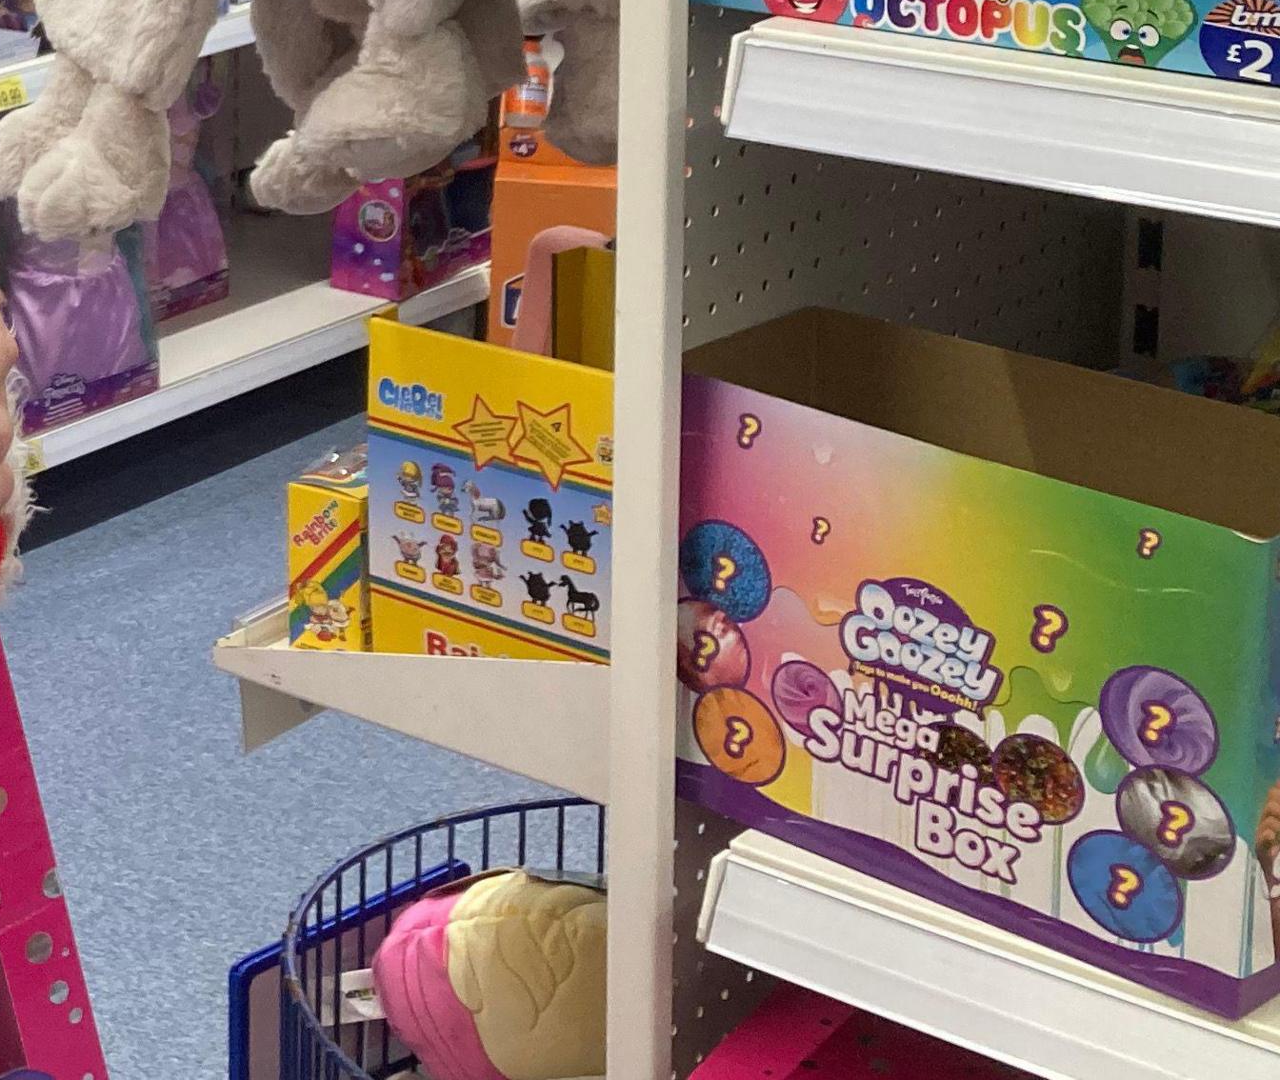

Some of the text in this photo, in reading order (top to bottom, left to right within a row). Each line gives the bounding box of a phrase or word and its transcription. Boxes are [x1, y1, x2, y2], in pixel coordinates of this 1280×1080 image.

[292, 500, 339, 547] Rainbow
[843, 615, 998, 700] Goozey
[859, 582, 989, 662] Oozey
[844, 688, 940, 753] Mega
[805, 706, 1041, 841] Surprise
[916, 797, 1021, 886] Box
